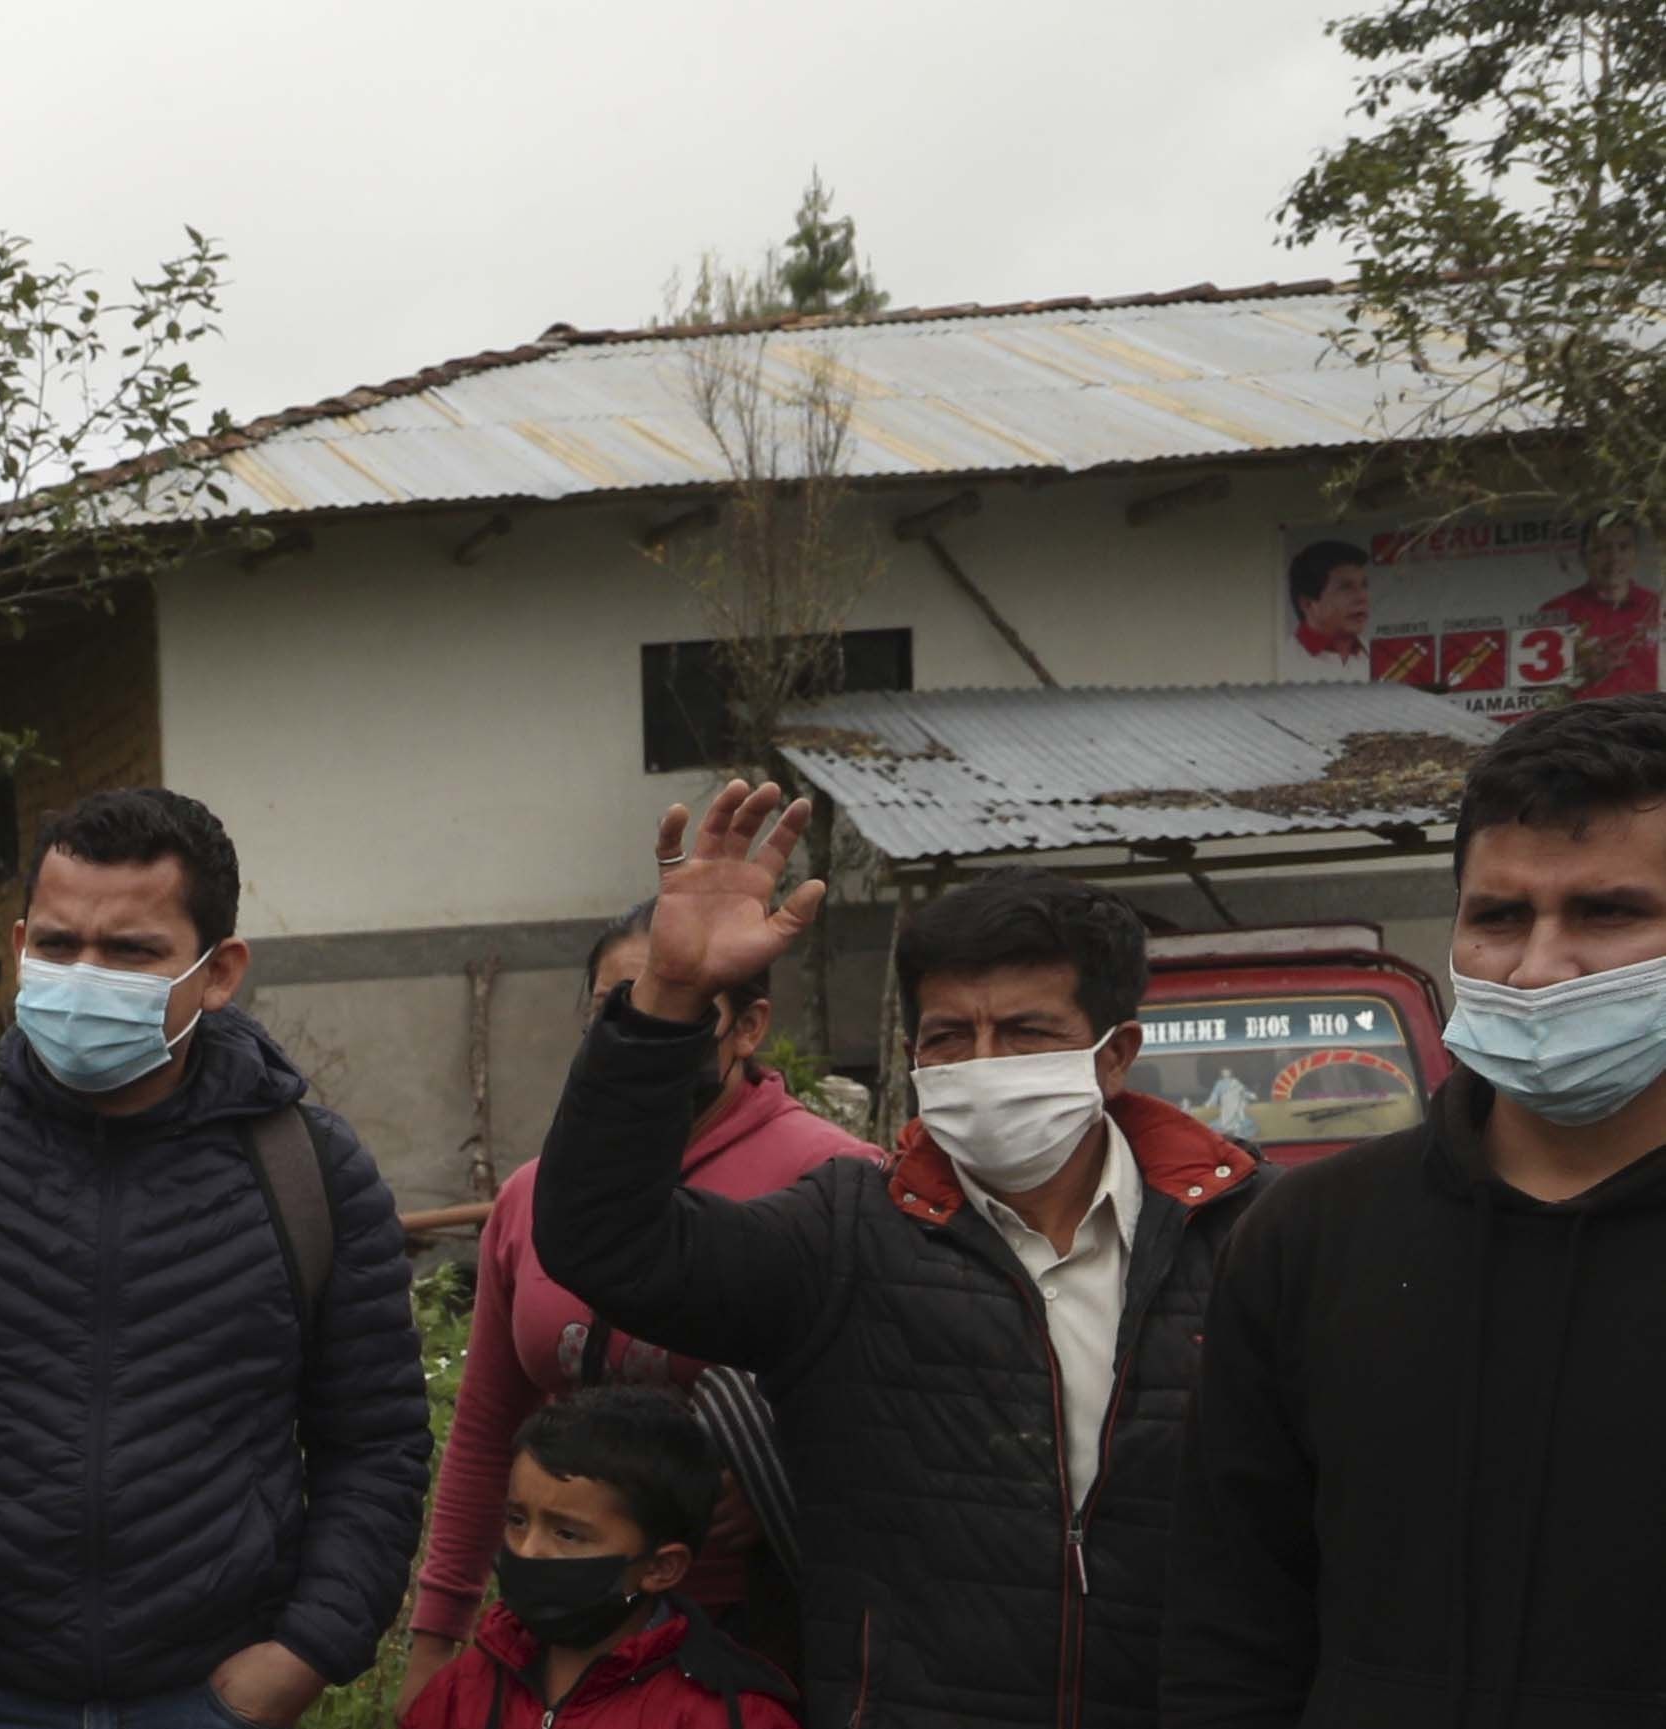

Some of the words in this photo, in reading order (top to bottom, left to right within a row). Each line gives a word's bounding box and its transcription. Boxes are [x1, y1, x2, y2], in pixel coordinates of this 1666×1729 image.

[1518, 629, 1565, 683] 3
[1245, 1015, 1291, 1040] DIOS
[1308, 1013, 1349, 1038] MIO
